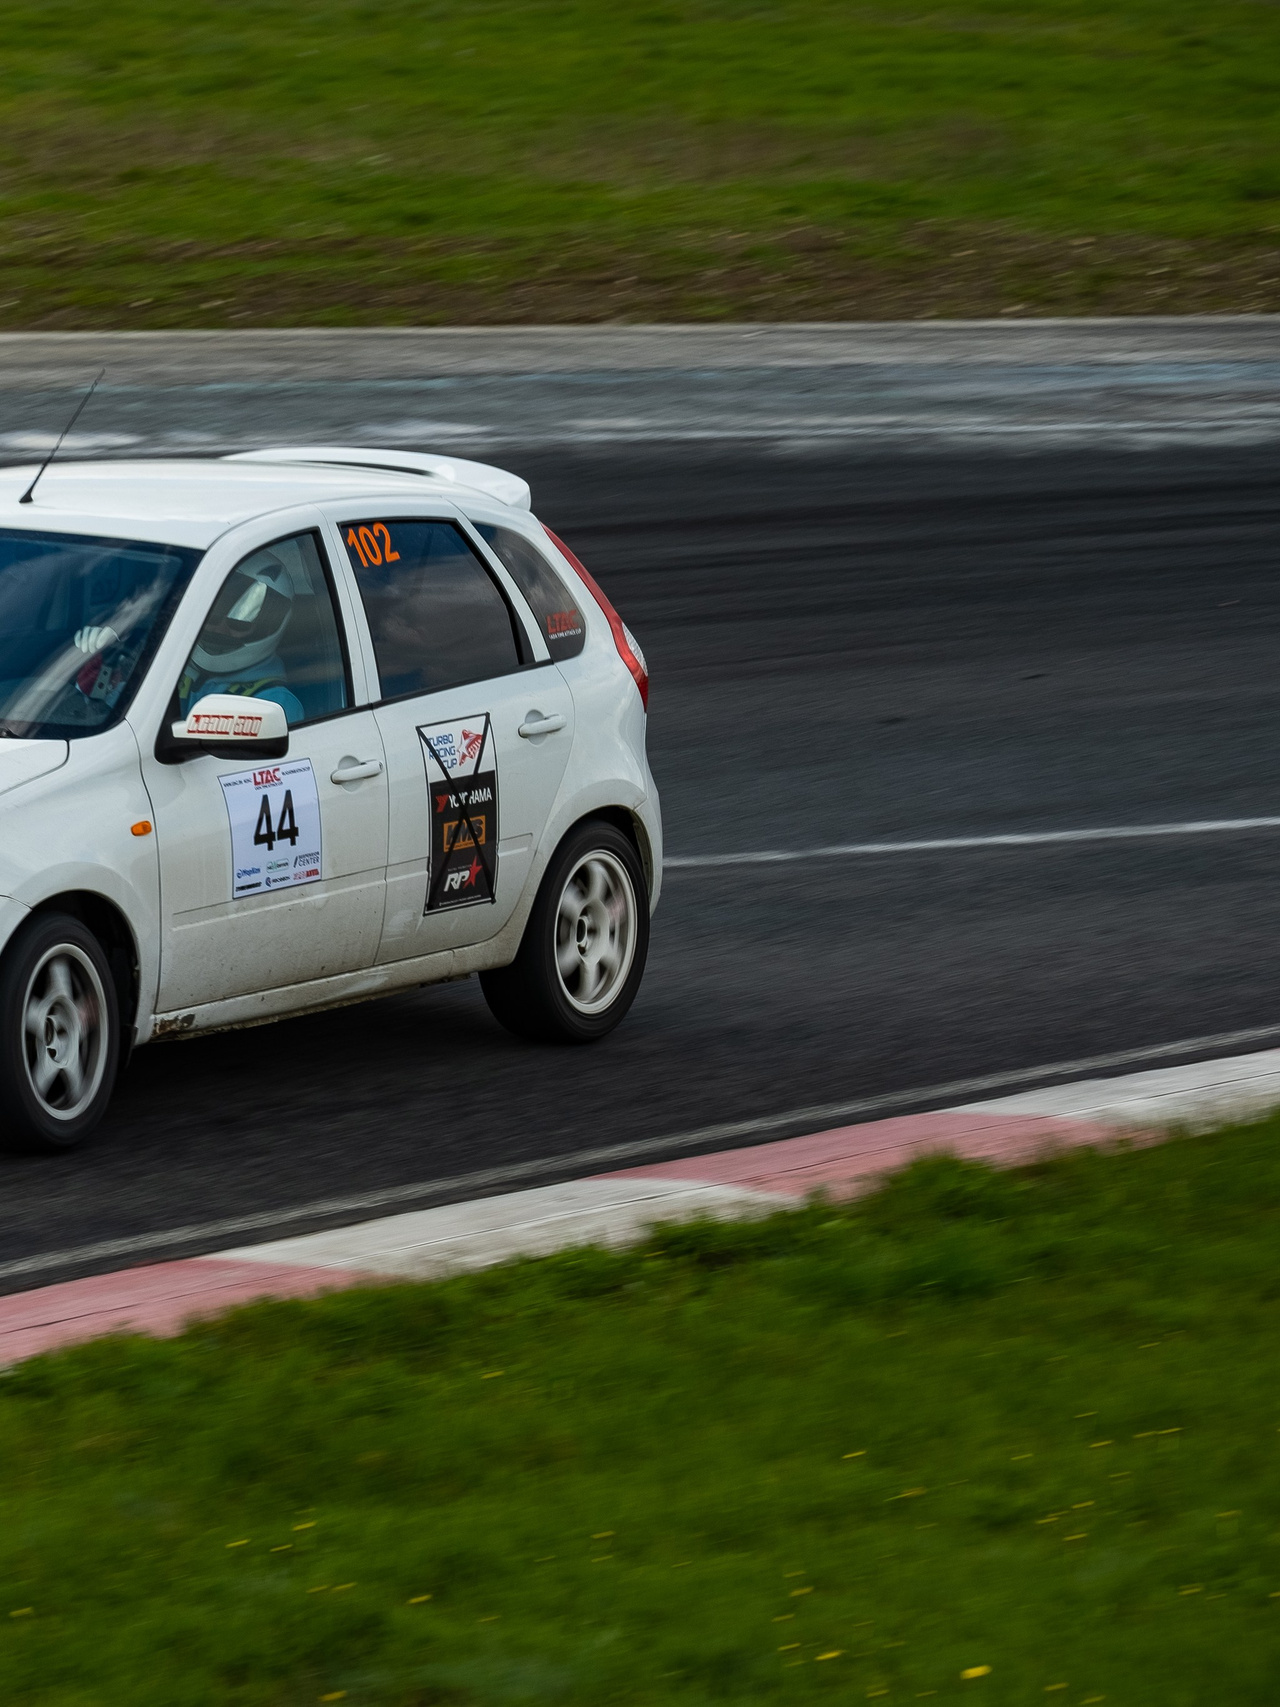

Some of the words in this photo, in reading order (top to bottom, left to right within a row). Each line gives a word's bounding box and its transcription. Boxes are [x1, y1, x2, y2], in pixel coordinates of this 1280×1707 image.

[347, 522, 400, 568] 102
[546, 609, 579, 634] LTAC
[429, 745, 456, 760] RCING
[252, 767, 281, 786] LTAC
[254, 789, 299, 851] 44
[443, 870, 470, 892] RP
